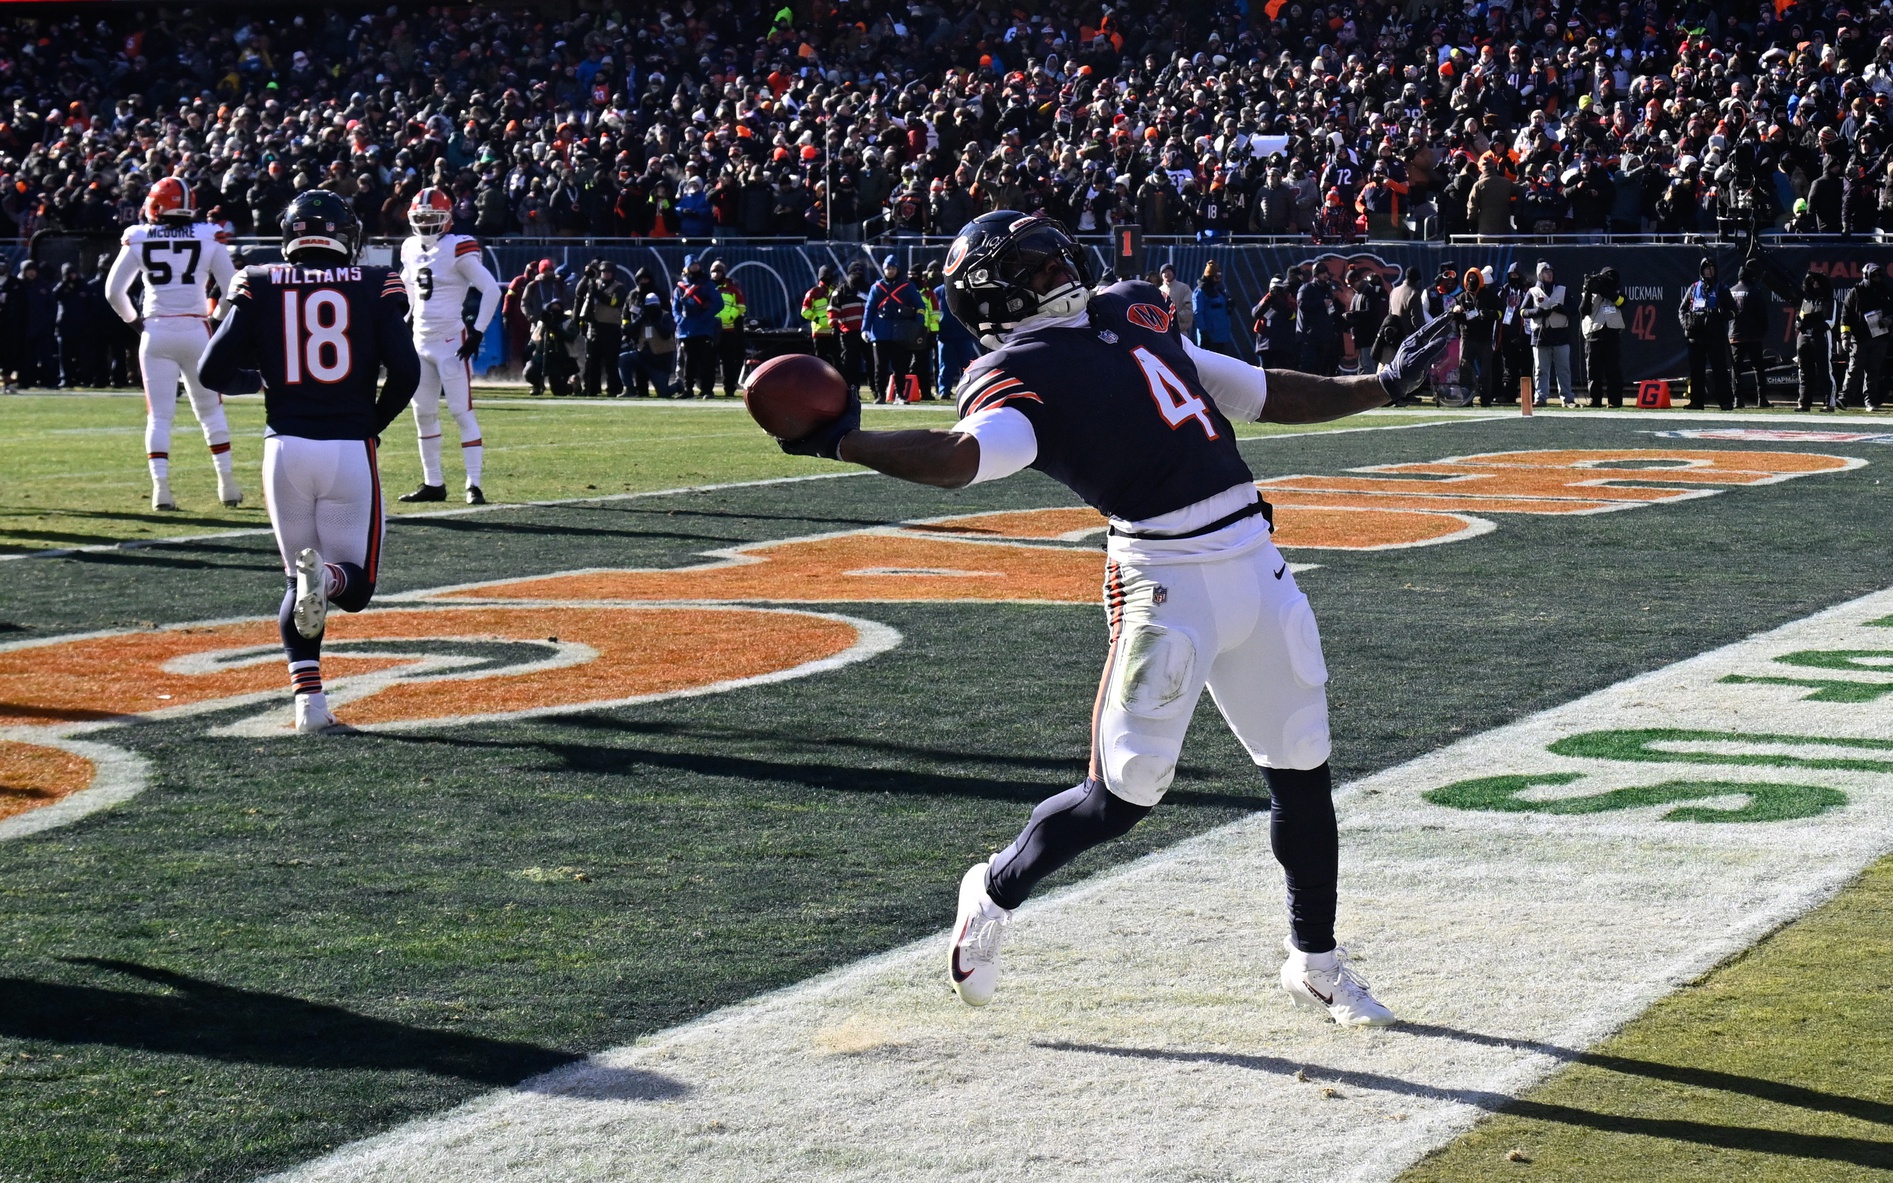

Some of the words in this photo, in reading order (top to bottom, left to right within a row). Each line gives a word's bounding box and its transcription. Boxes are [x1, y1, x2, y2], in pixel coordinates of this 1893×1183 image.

[1337, 168, 1352, 185] 72
[1207, 204, 1218, 220] 18
[1121, 231, 1133, 257] 1
[142, 240, 202, 285] 57
[270, 266, 363, 285] WILLIAMS
[416, 267, 434, 302] 9
[282, 288, 352, 385] 18
[1631, 304, 1657, 341] 42
[1129, 344, 1220, 442] 4
[1640, 383, 1661, 405] G
